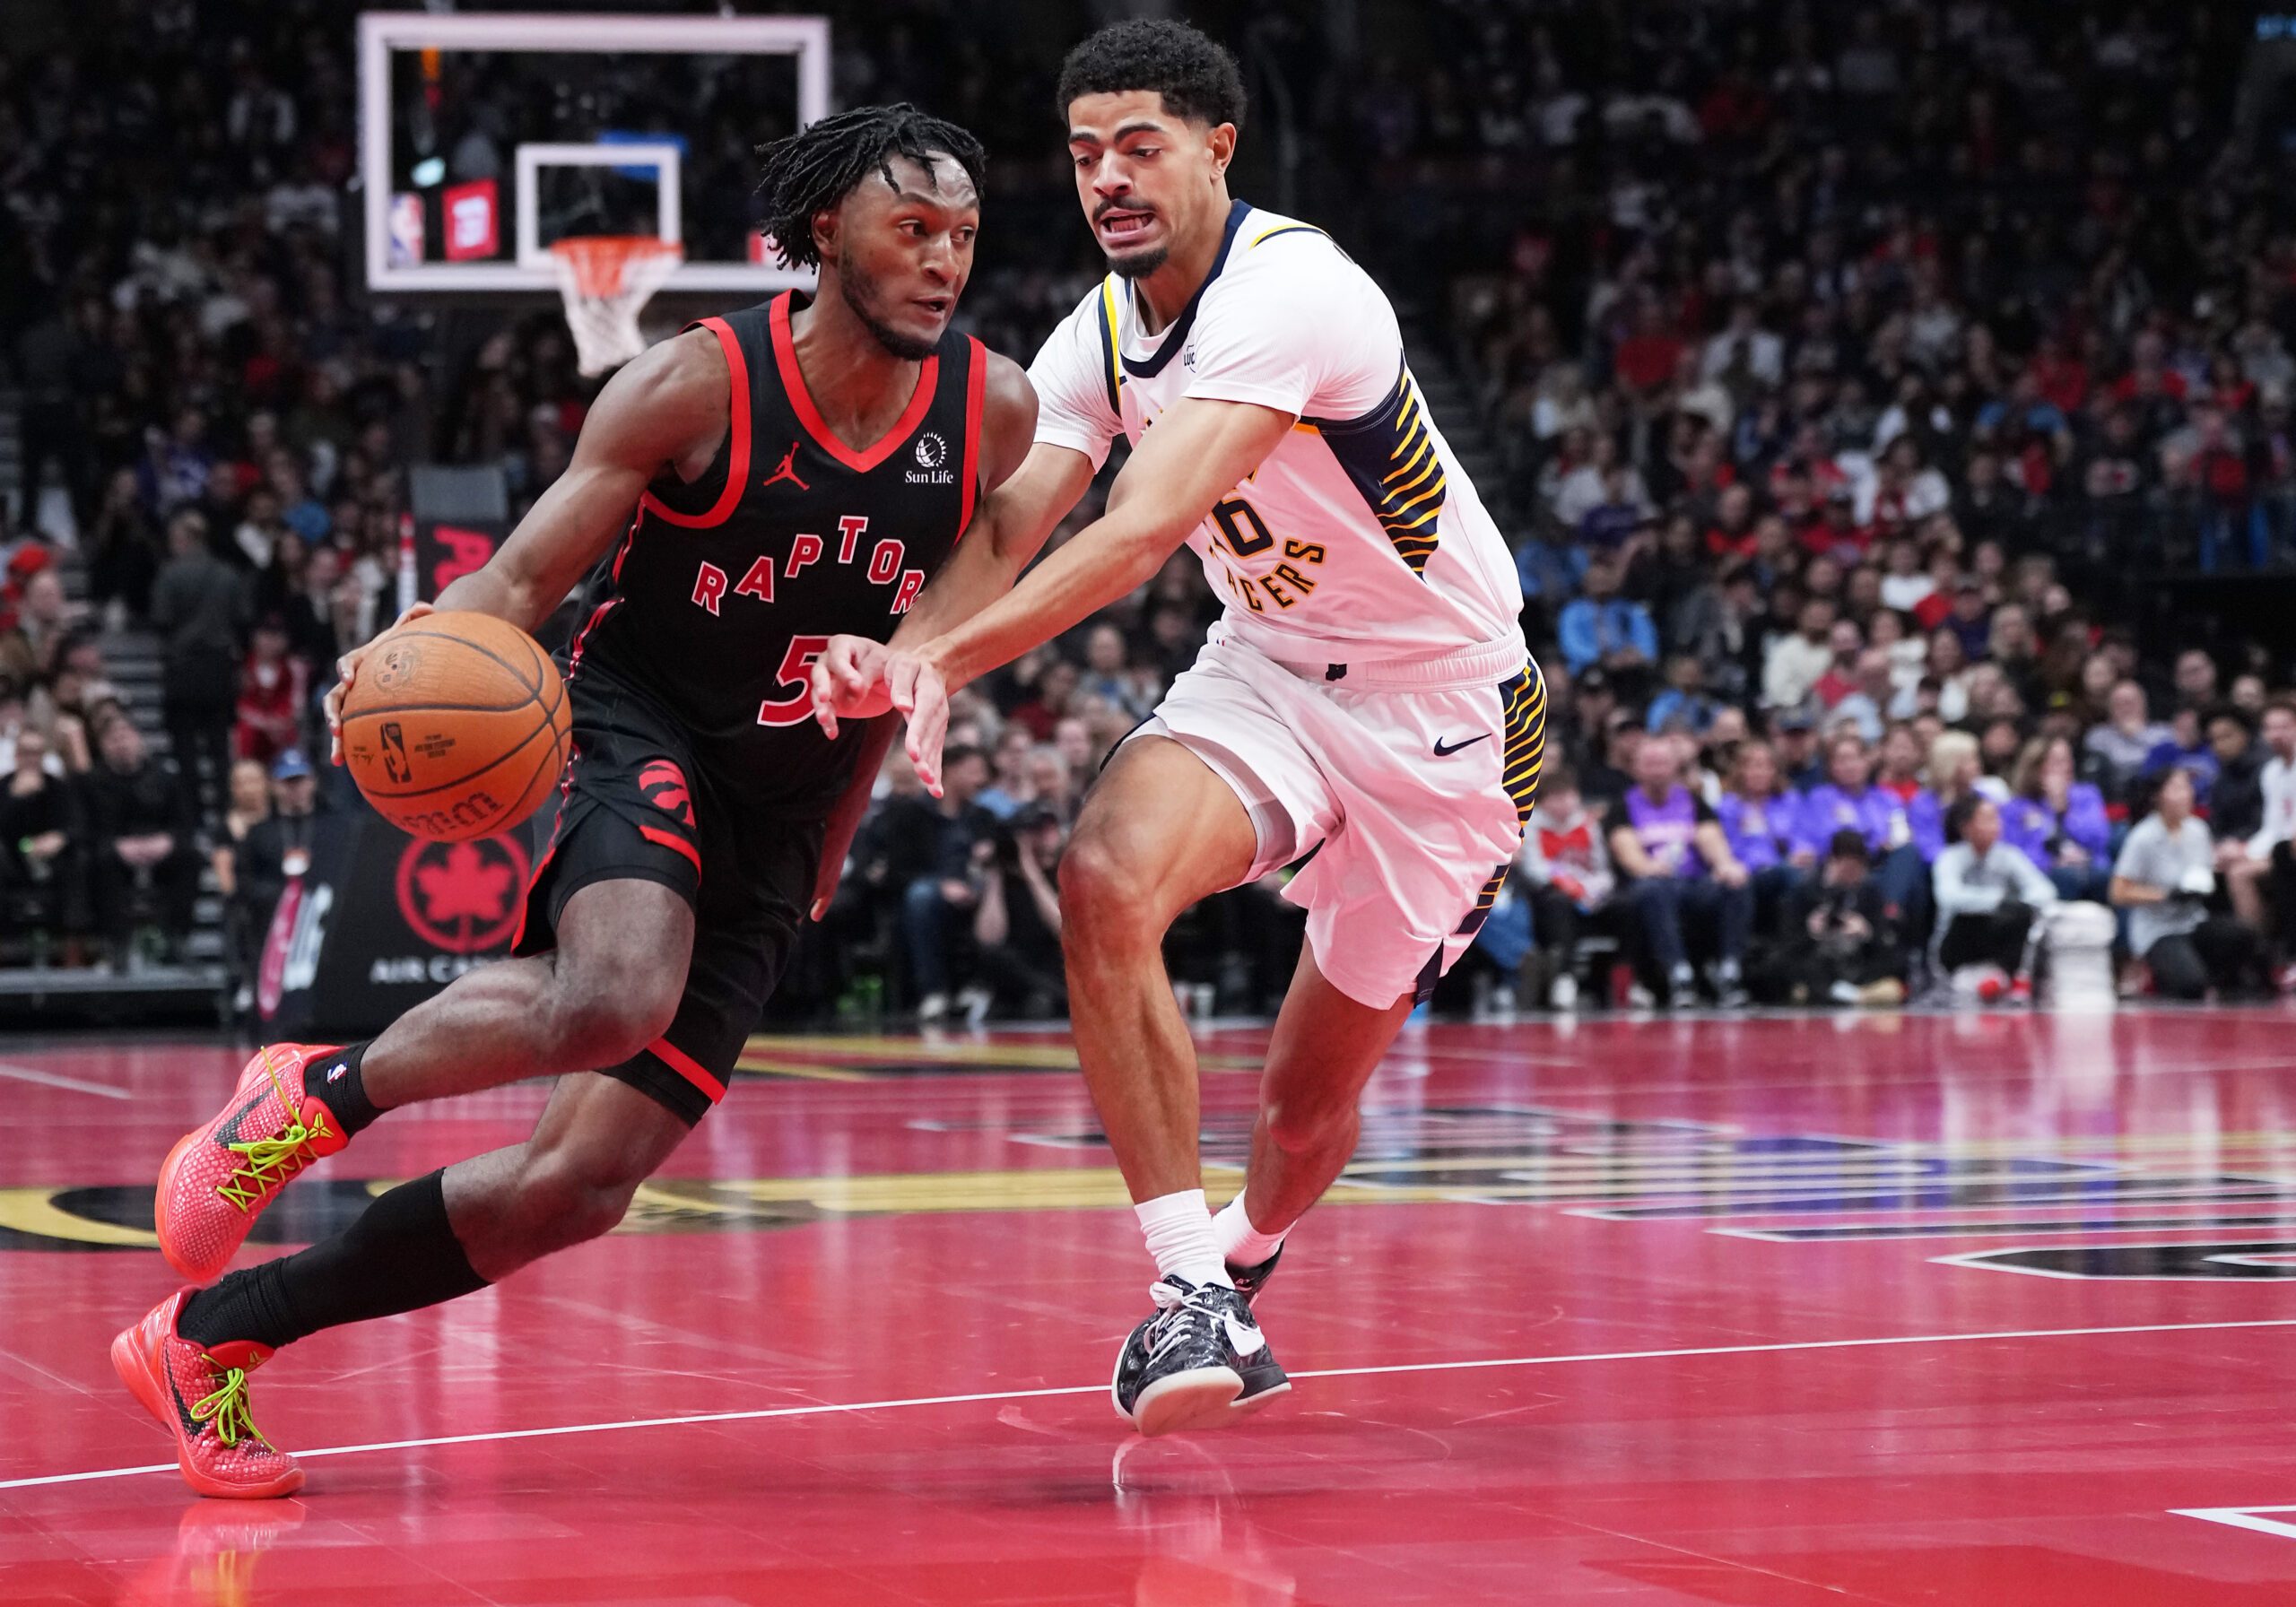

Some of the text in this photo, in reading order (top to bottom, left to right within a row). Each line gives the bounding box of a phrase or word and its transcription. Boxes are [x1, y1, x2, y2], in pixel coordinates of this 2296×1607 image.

[905, 469, 954, 484] Sun Life
[691, 515, 925, 617] RAPTOR
[757, 635, 832, 727] 5
